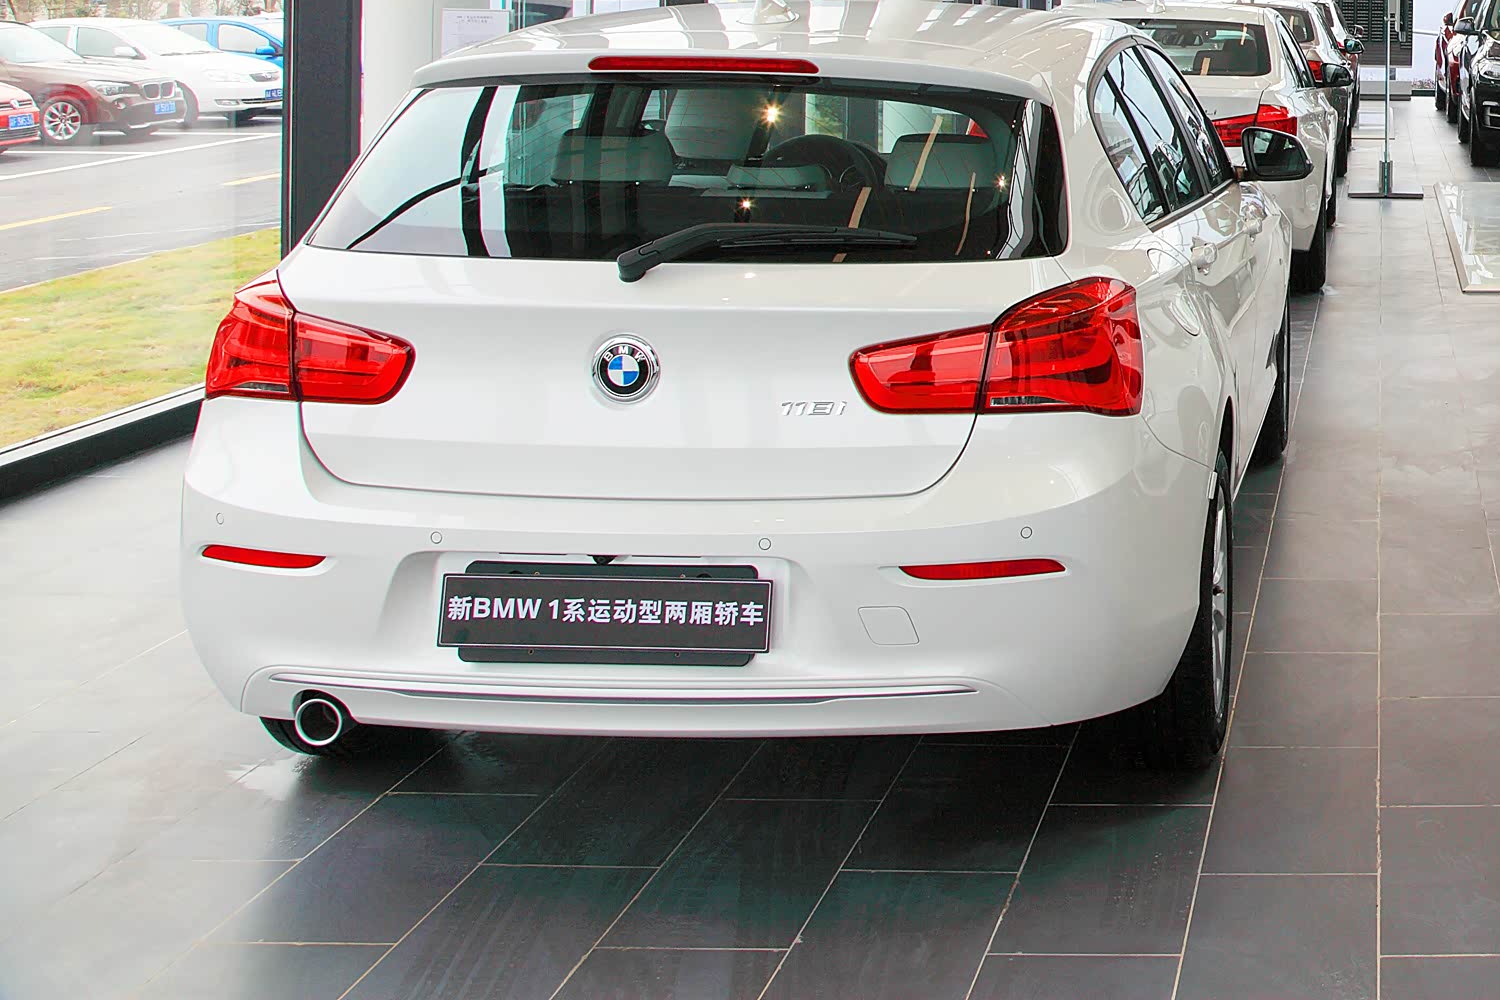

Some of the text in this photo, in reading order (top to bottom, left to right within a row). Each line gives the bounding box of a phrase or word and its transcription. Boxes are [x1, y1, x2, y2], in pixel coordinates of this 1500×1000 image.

[603, 345, 646, 363] BMW
[781, 401, 848, 416] 118i
[448, 595, 764, 626] 新BMW 1系运动型两厢轿车
